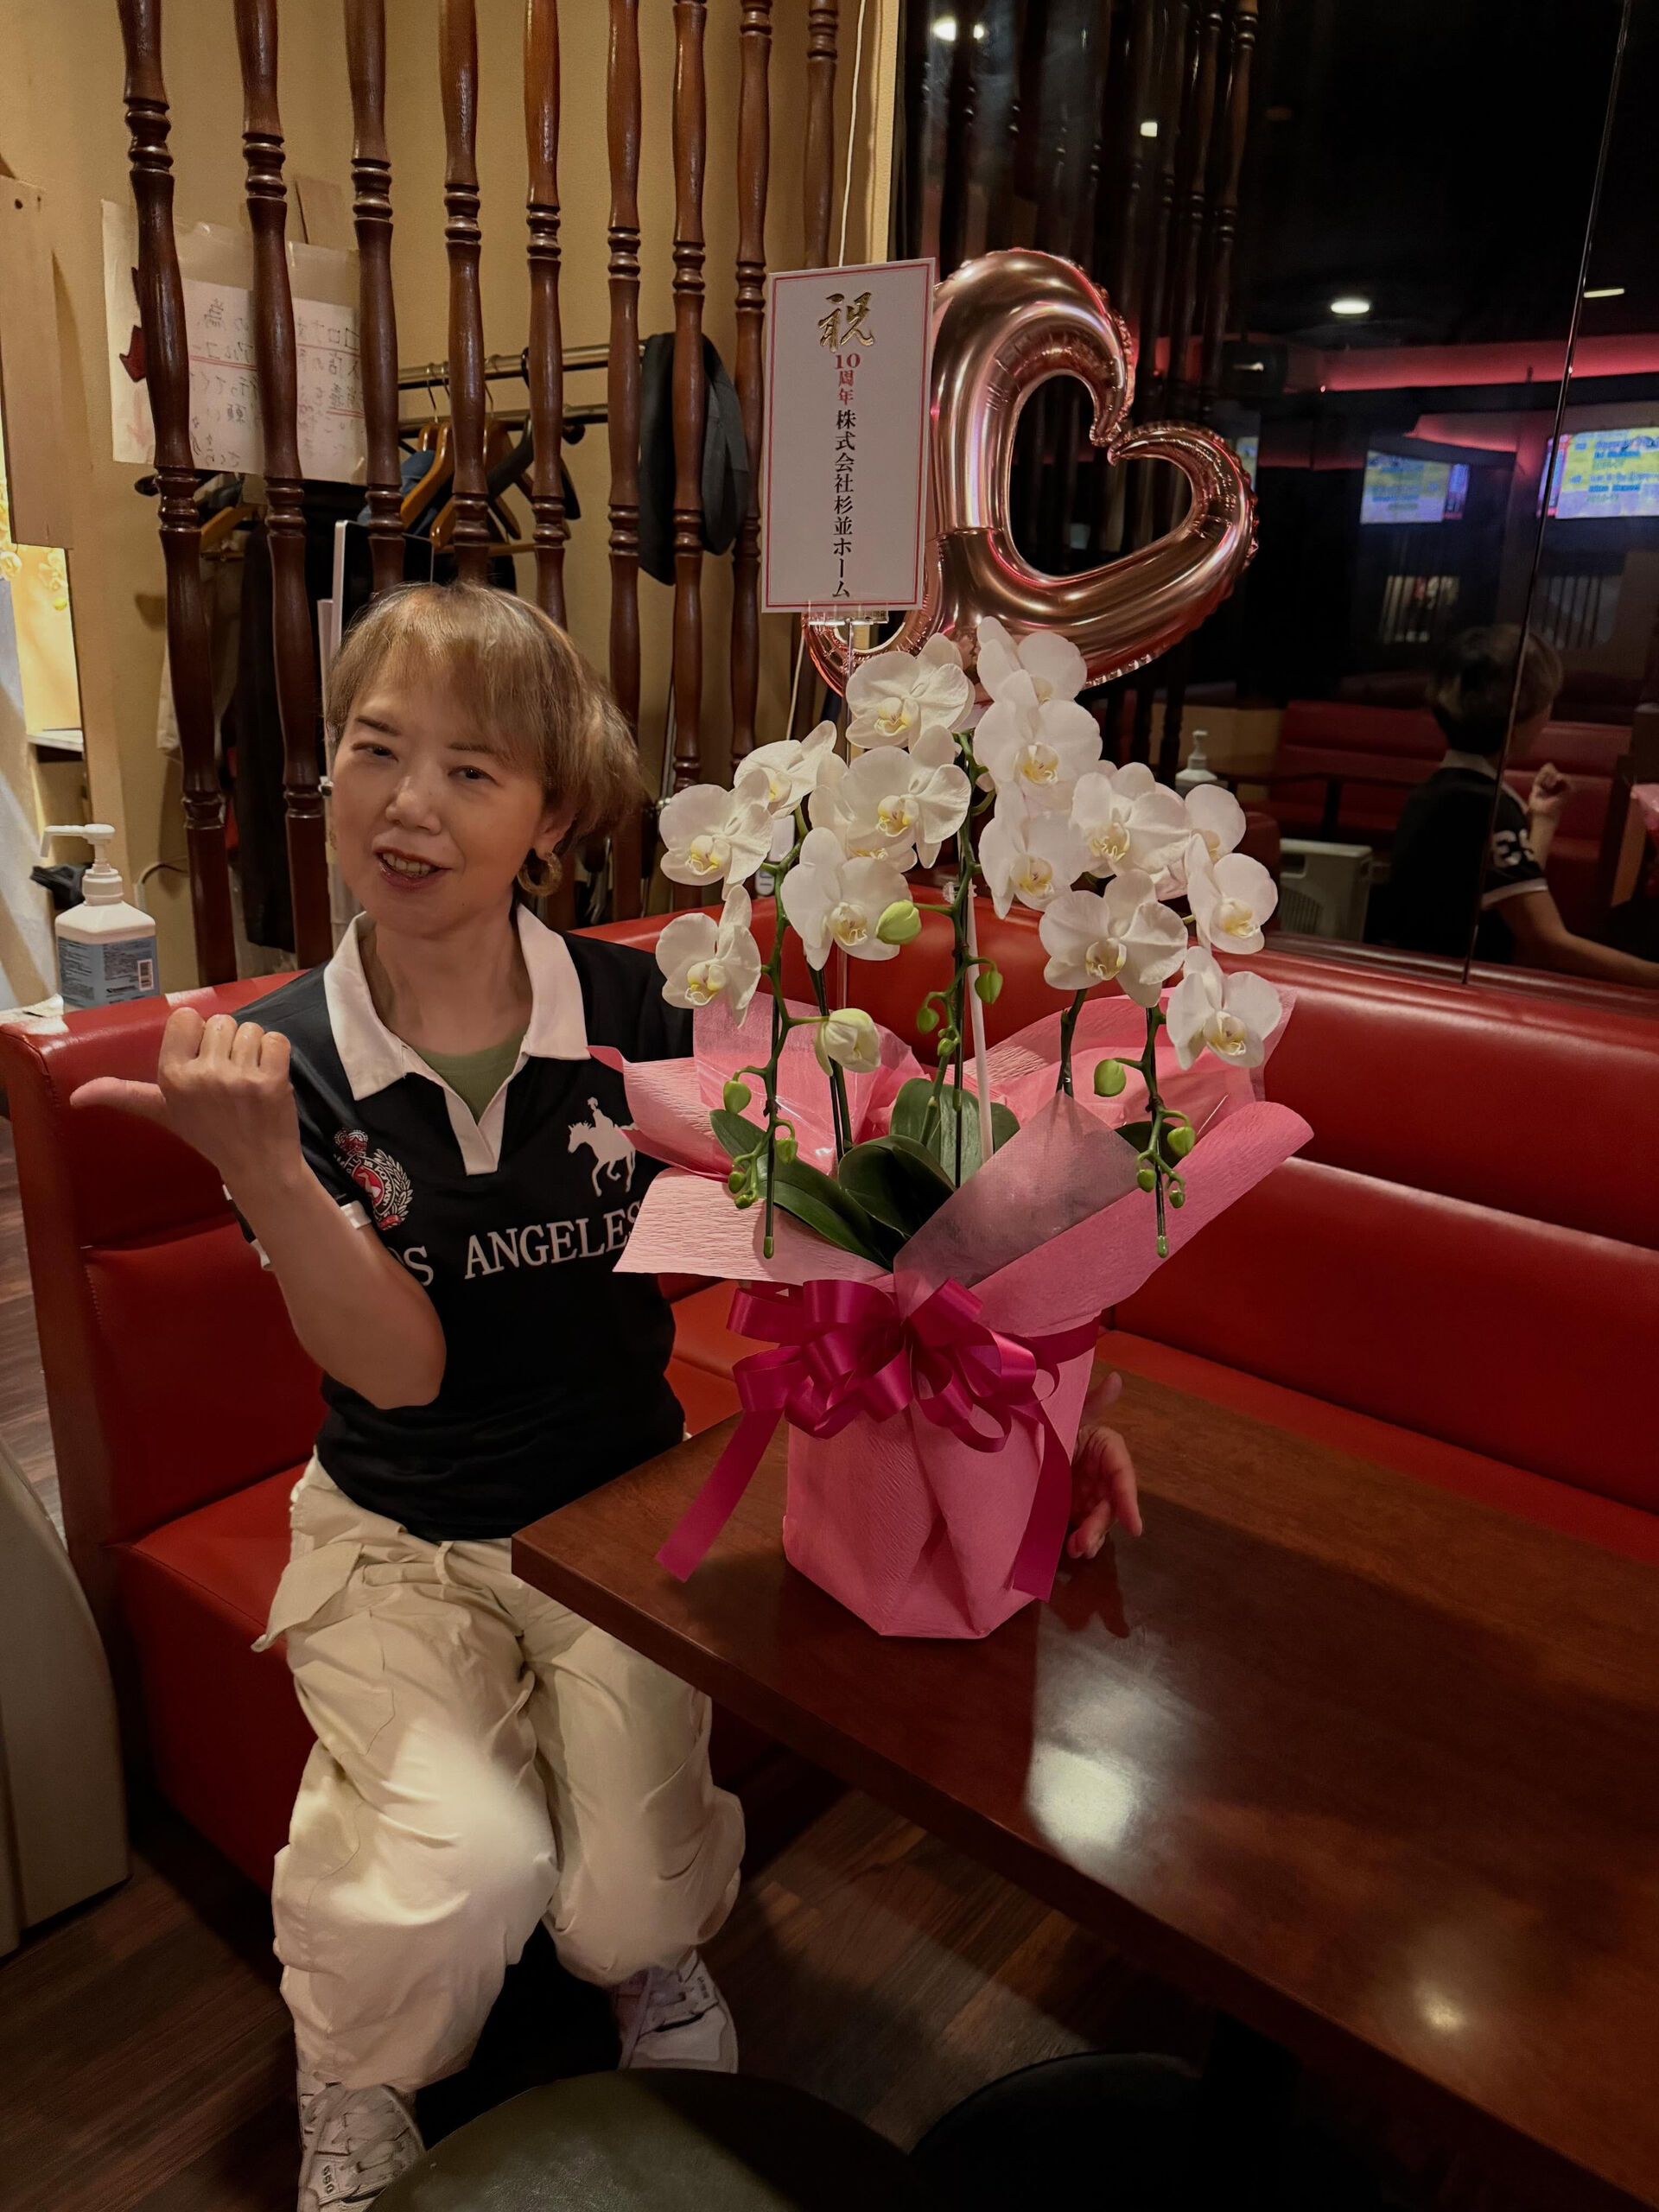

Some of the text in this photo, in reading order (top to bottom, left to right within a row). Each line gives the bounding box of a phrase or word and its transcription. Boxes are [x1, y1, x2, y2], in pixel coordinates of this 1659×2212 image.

[817, 291, 875, 353] 祝
[834, 353, 861, 406] 10周年
[832, 410, 857, 598] 株式会社杉並ホーム
